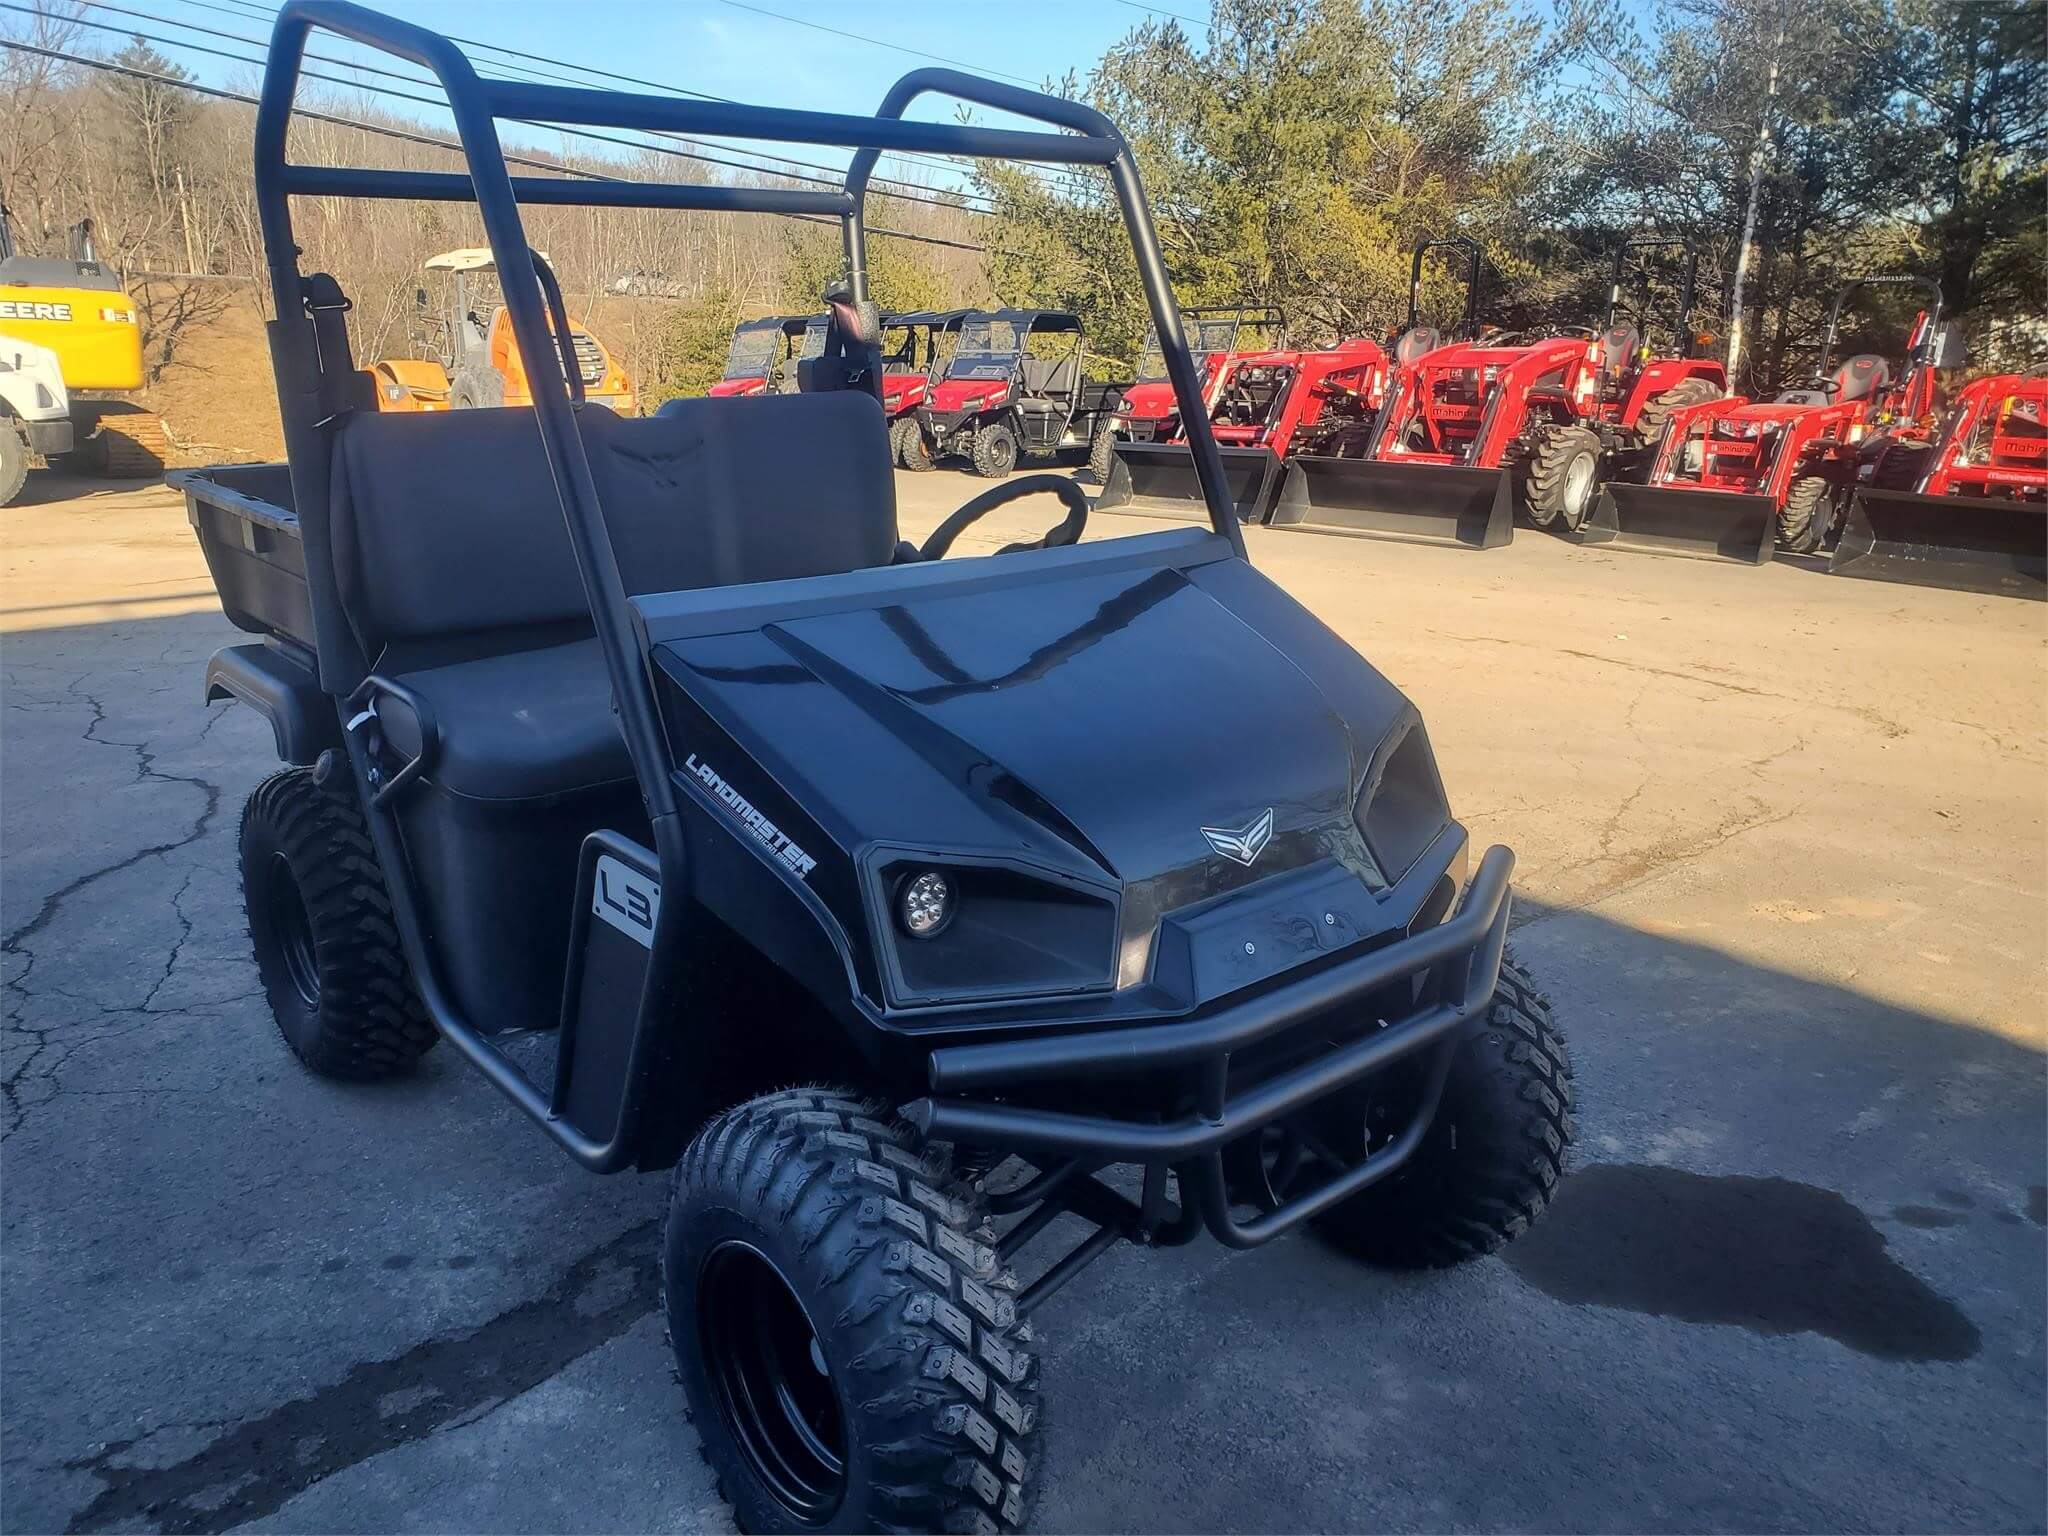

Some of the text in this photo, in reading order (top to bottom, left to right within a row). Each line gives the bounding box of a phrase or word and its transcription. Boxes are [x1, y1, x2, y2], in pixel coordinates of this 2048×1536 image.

[685, 753, 818, 875] LANDMASTER
[743, 821, 779, 857] AMERICAN
[600, 868, 653, 931] L3
